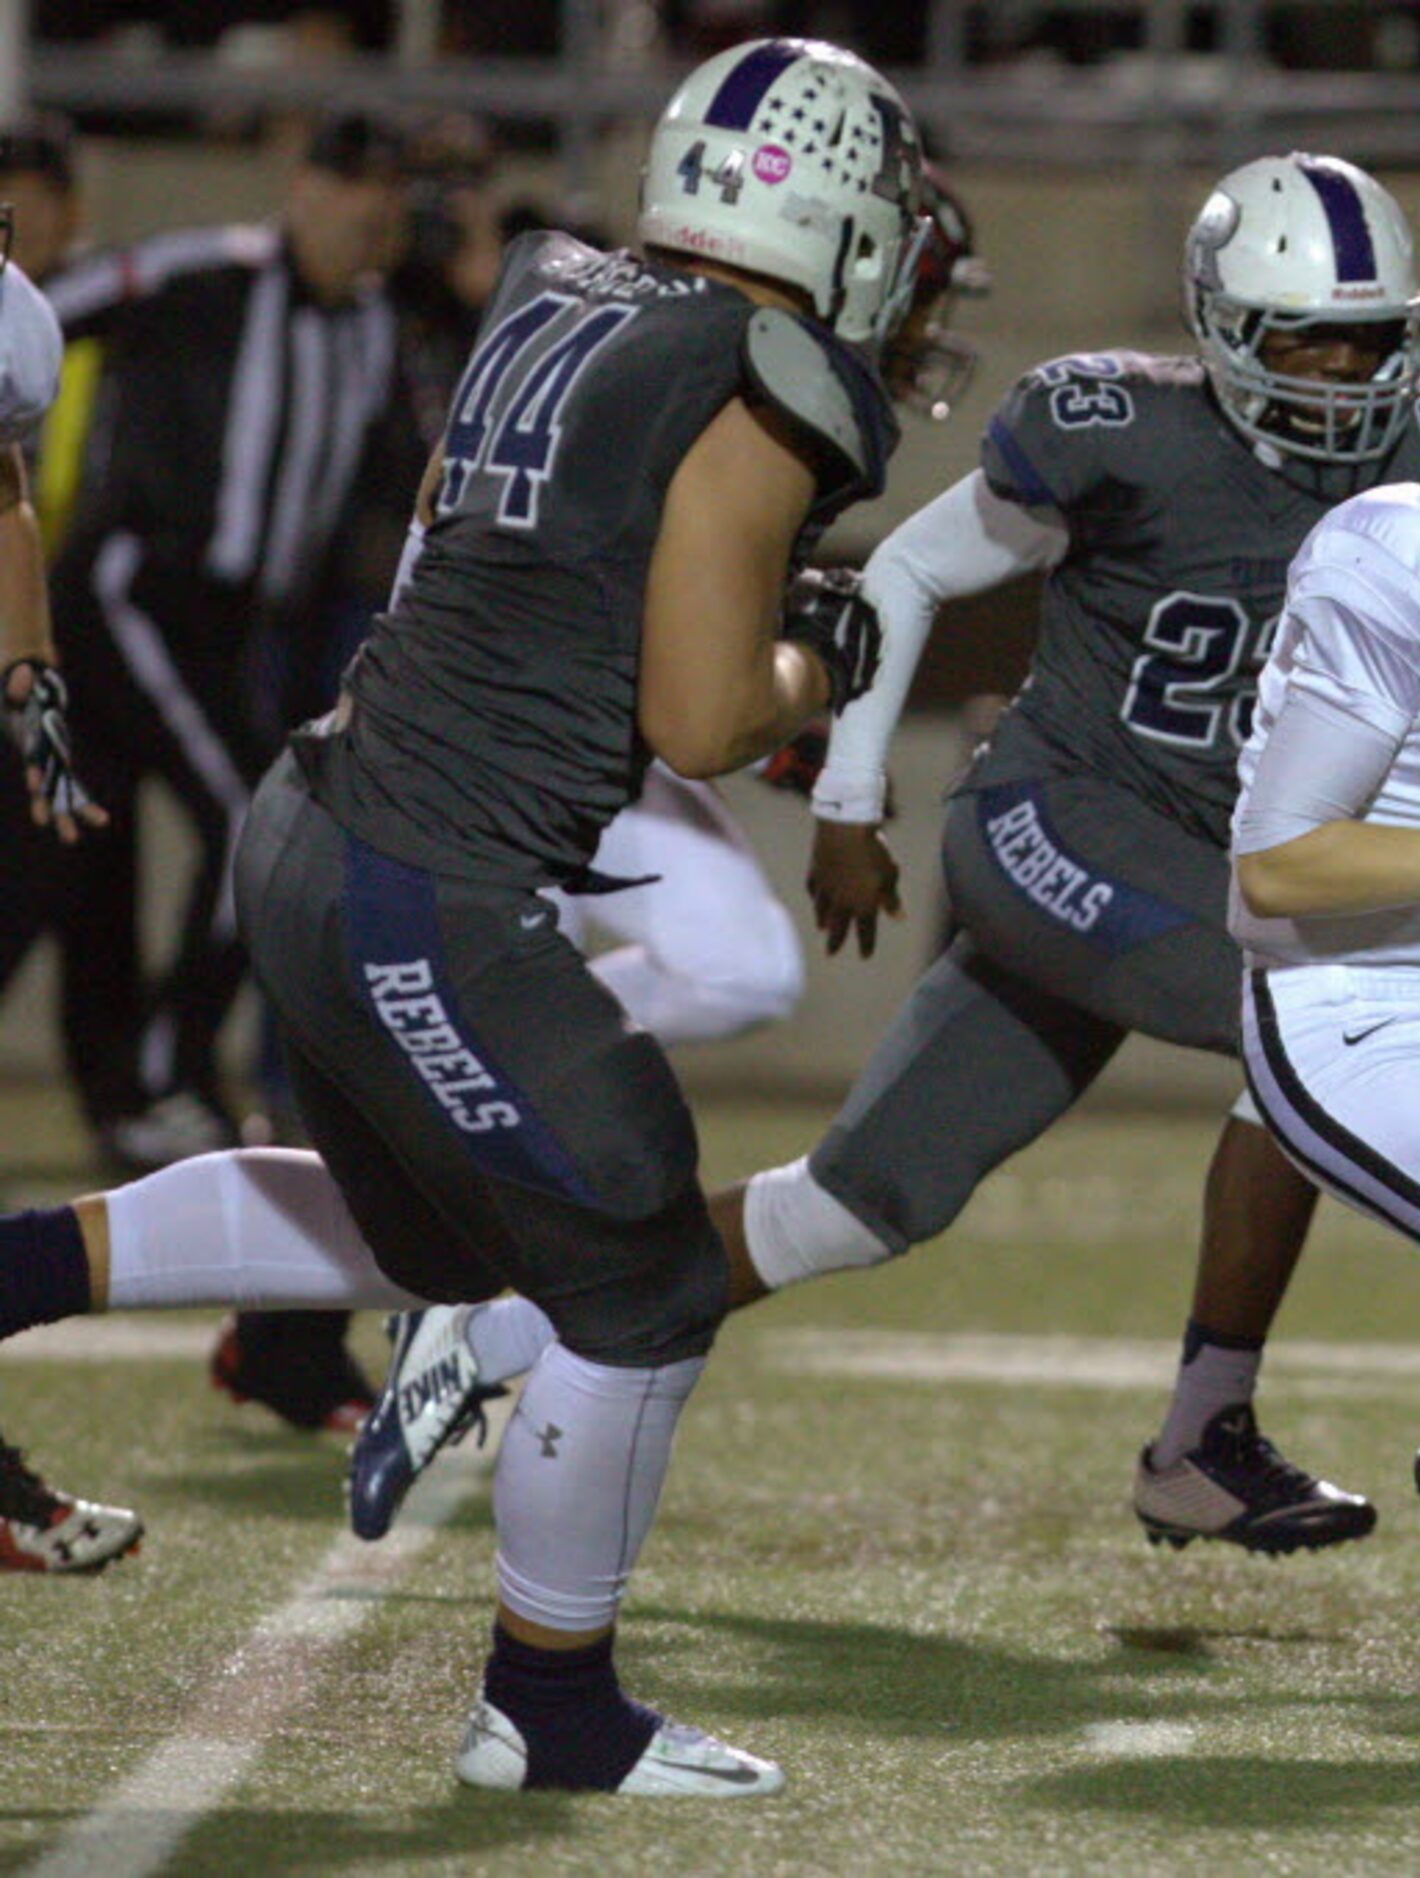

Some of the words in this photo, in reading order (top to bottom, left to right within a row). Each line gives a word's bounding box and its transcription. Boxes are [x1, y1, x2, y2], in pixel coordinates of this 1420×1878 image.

[677, 140, 745, 205] 44
[437, 290, 642, 530] 44
[1038, 352, 1134, 430] 23
[986, 800, 1114, 932] REBELS
[363, 957, 521, 1134] REBELS
[401, 1350, 462, 1424] NIKE
